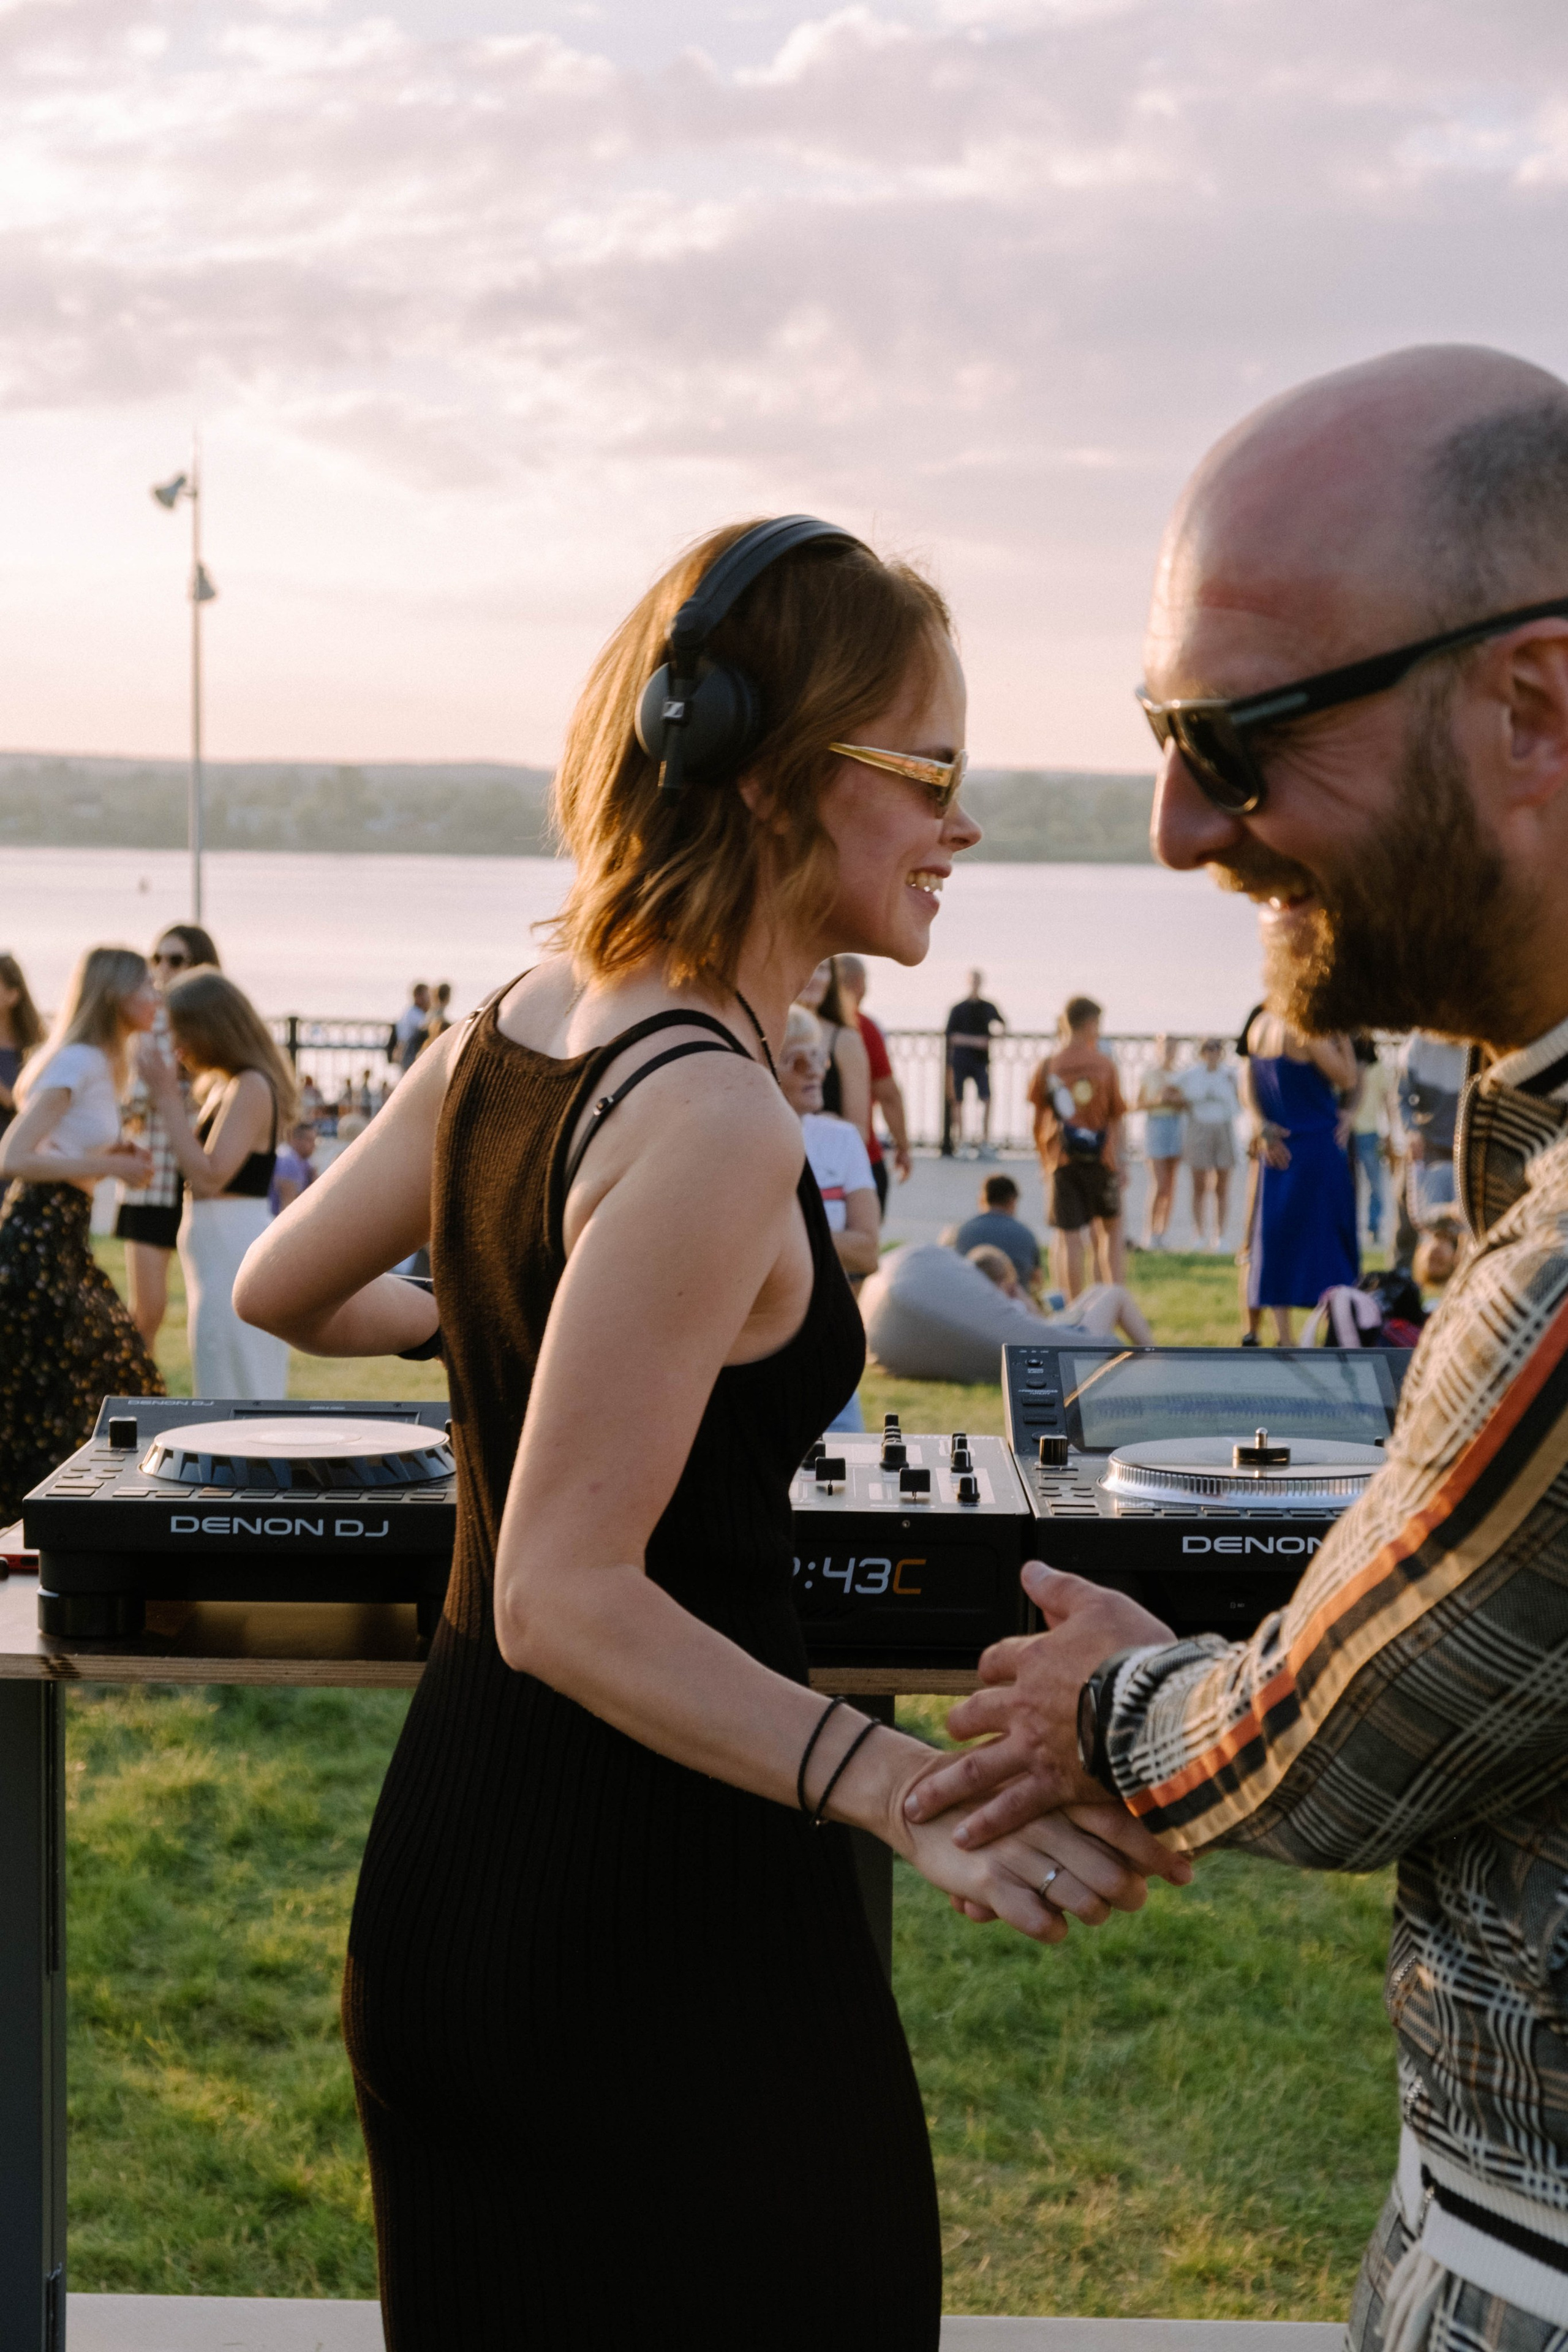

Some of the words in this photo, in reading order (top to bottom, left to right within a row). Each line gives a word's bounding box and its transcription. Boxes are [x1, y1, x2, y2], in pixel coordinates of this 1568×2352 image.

[170, 1515, 324, 1536] DENON
[334, 1519, 389, 1537] DJ
[793, 1556, 927, 1595] :43C
